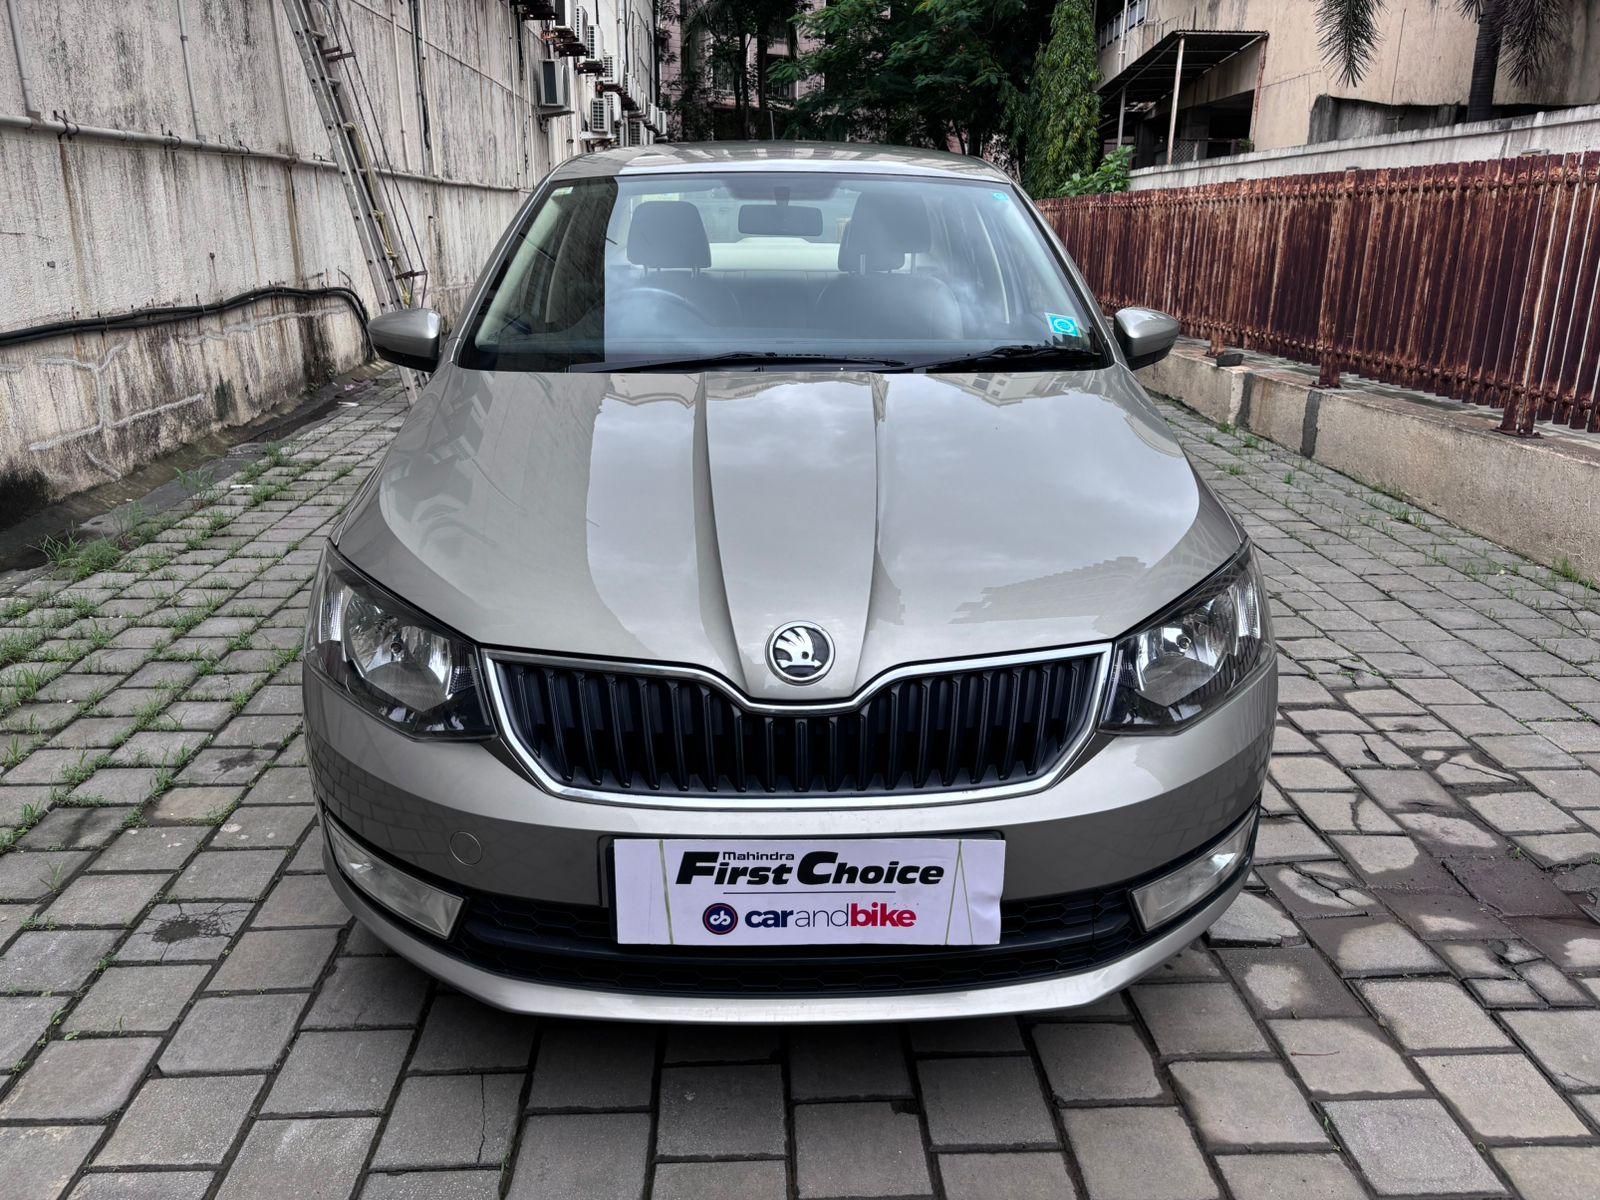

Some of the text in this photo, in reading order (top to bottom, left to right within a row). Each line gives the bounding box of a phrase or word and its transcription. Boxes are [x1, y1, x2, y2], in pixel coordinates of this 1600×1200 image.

[722, 851, 795, 861] Mahindra
[675, 851, 945, 885] First Choice
